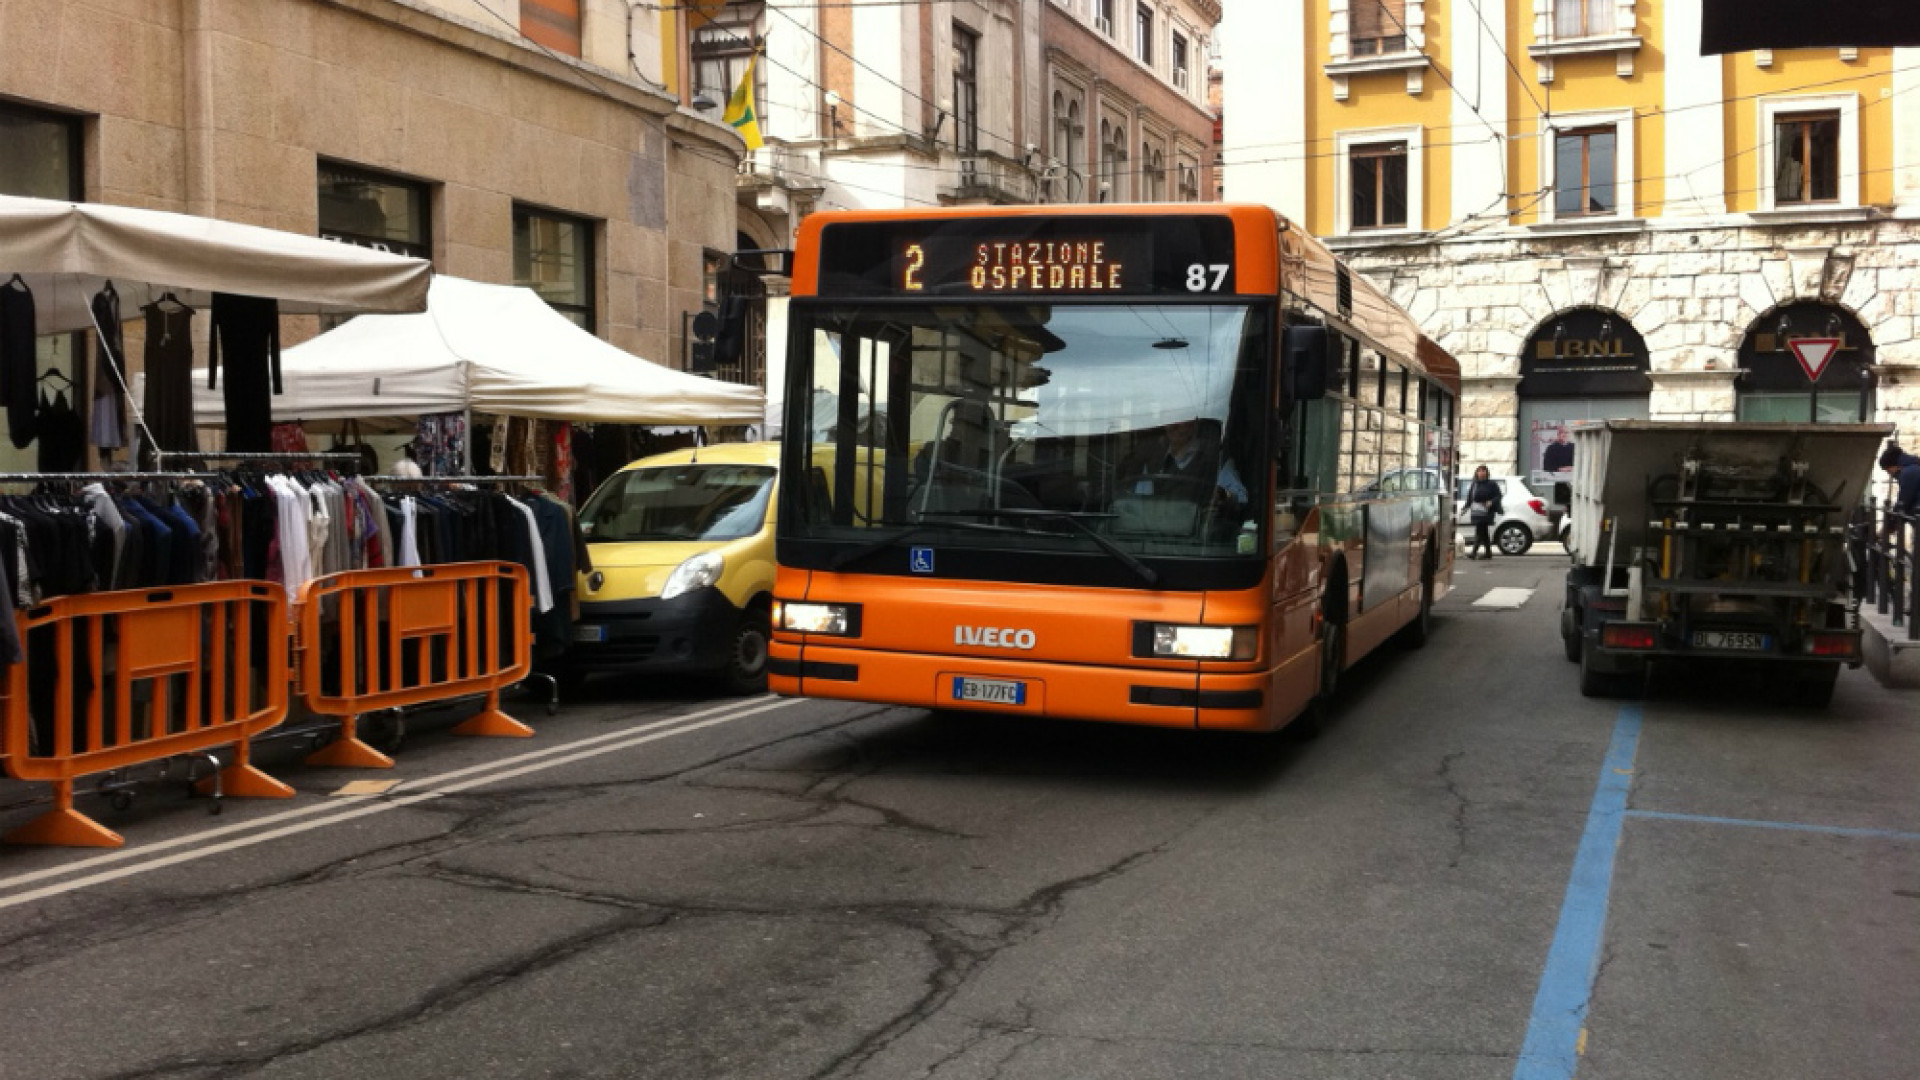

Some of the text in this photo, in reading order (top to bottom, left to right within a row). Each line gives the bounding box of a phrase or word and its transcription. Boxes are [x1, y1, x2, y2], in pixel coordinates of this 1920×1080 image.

[977, 242, 1105, 264] STAZIONE
[904, 245, 924, 290] 2
[971, 264, 1123, 290] OSPEDALE
[1186, 264, 1229, 292] 87
[1563, 337, 1635, 358] BNL
[954, 625, 1036, 649] IVECO
